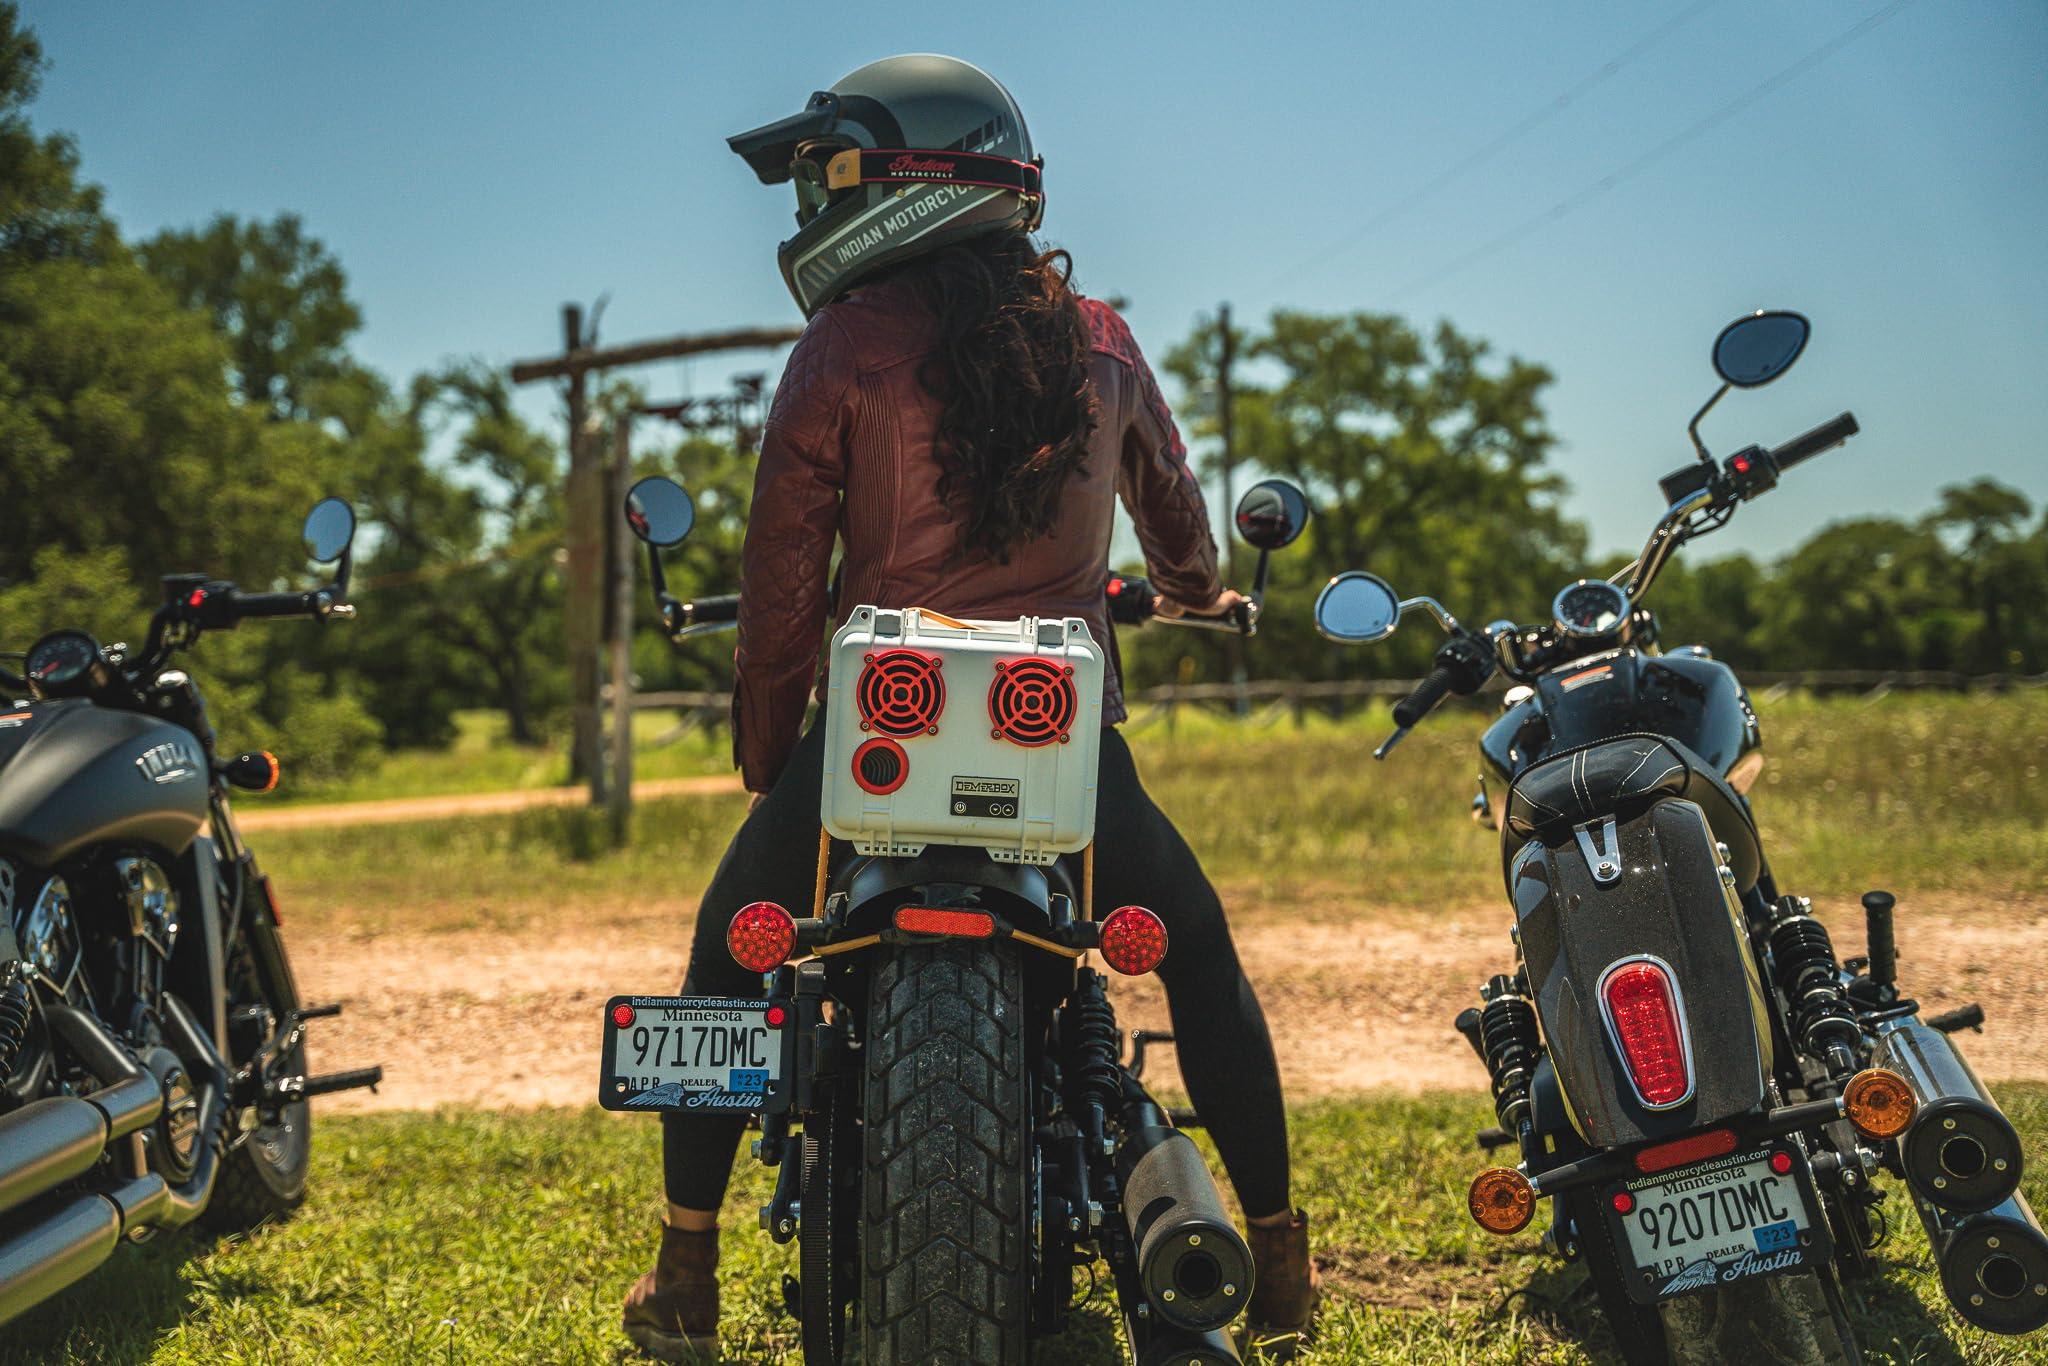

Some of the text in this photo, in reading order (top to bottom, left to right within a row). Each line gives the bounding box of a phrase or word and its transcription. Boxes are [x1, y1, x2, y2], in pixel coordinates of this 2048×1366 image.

[888, 154, 956, 172] Indian
[836, 184, 977, 264] INDIAN MOTORCYCL
[955, 781, 1015, 794] DEMERBOX
[632, 996, 769, 1009] indianmotorcycleaustin.com
[662, 1009, 742, 1022] Minnesota
[633, 1026, 768, 1068] 9717DMC
[681, 1078, 718, 1087] DEALER
[744, 1074, 762, 1087] 23
[686, 1086, 764, 1108] Austin
[1626, 1149, 1771, 1191] indianmotorcycleaustin.com
[1662, 1167, 1747, 1198] Minnesota
[1639, 1177, 1788, 1250] 9207DMC
[1773, 1226, 1790, 1242] 23
[1706, 1243, 1747, 1260] DEALER
[1722, 1250, 1803, 1281] Austin
